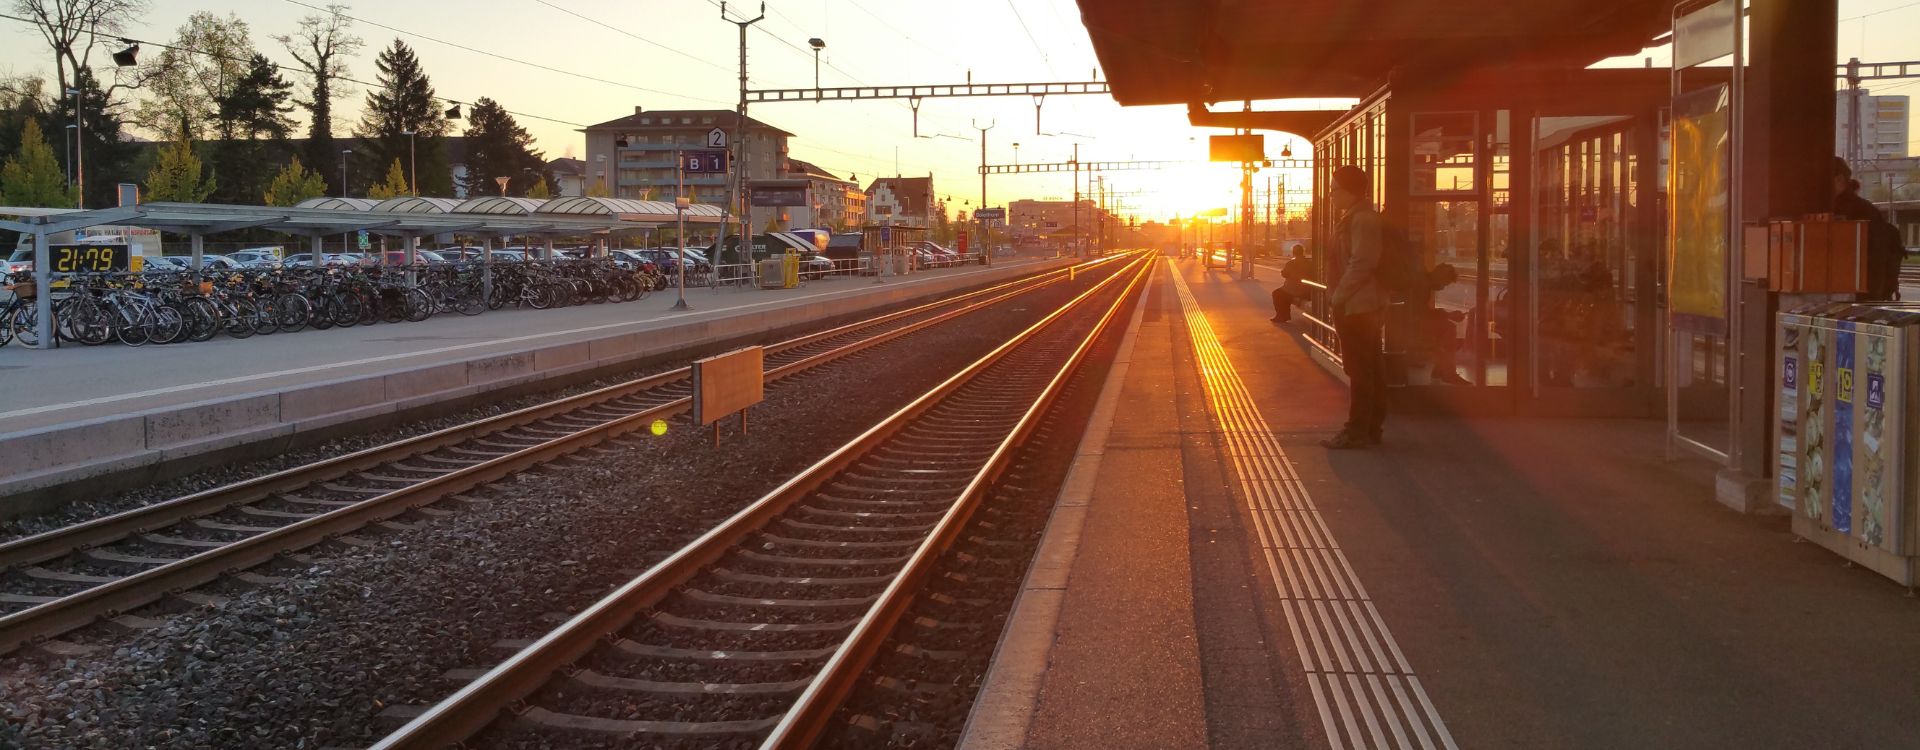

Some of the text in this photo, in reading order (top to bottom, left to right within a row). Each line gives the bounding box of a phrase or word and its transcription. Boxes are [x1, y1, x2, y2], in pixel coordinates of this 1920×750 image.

[713, 131, 722, 145] 2
[690, 158, 719, 170] B 1
